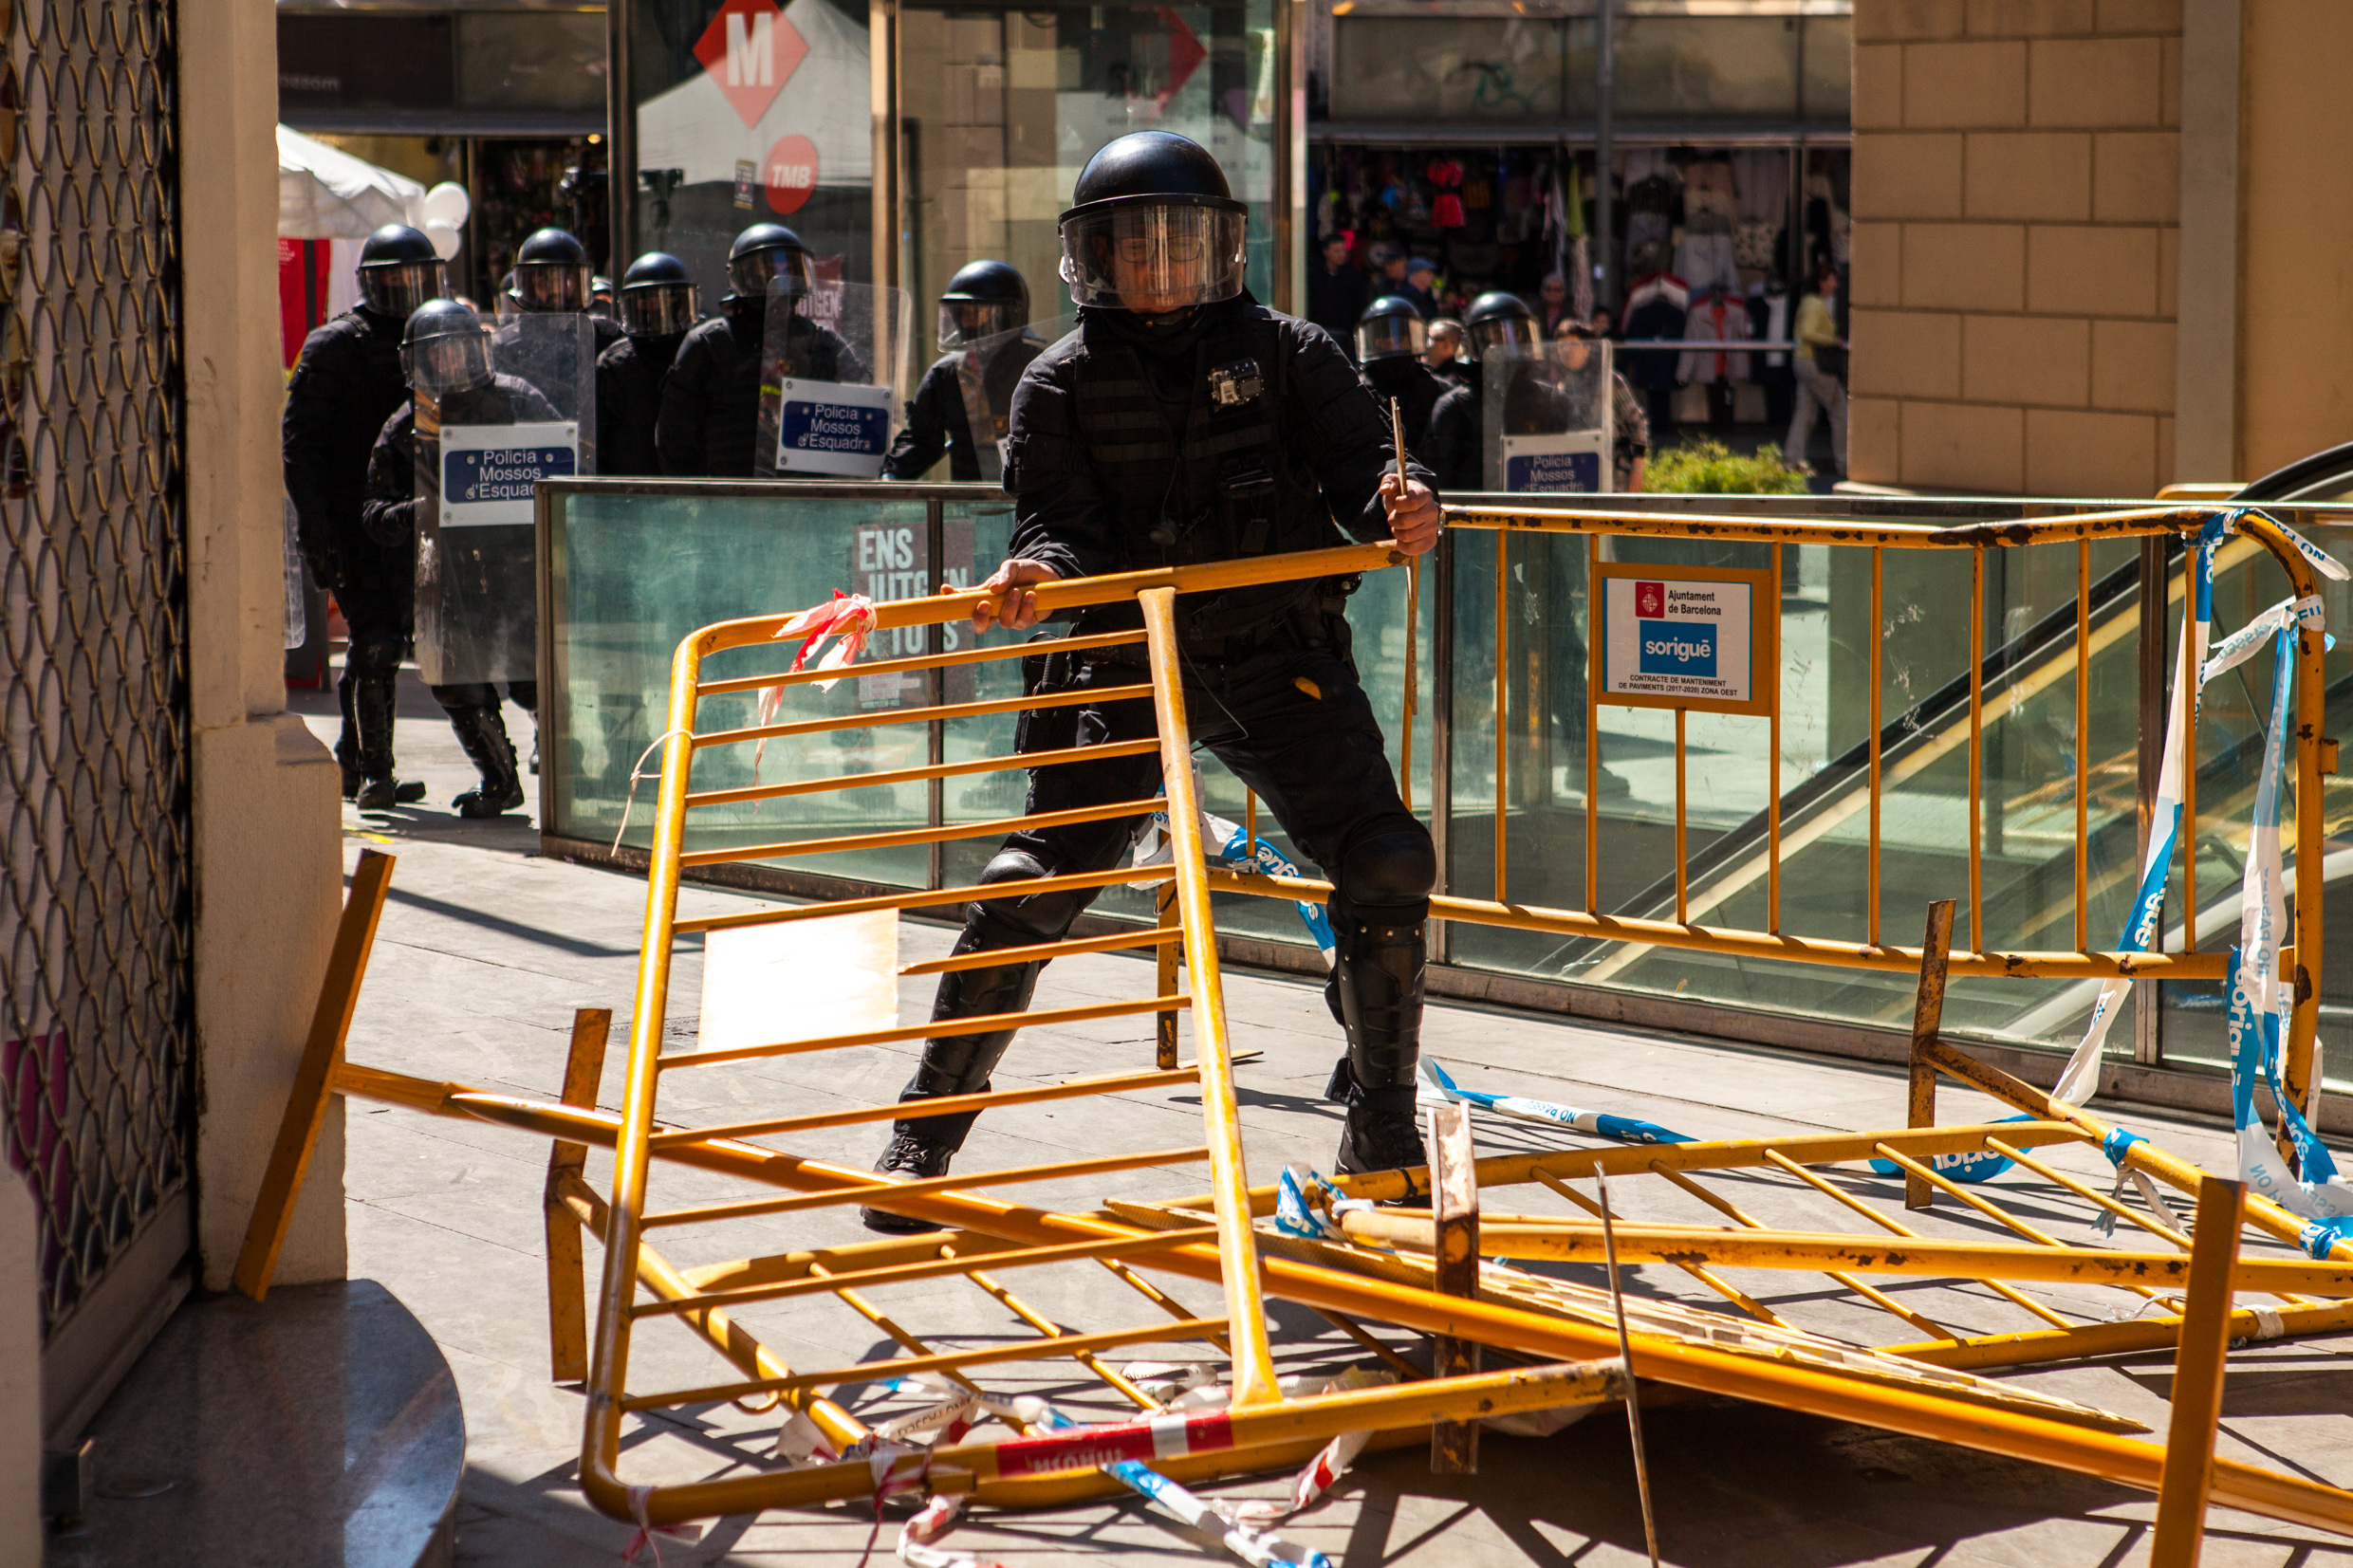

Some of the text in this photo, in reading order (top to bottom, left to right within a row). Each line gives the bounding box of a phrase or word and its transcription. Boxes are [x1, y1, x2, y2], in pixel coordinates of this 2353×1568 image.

[725, 11, 773, 87] M
[771, 165, 811, 189] TMB
[815, 404, 859, 420] Policia
[810, 418, 861, 435] Mossos
[798, 433, 871, 452] d'Esquadra
[483, 449, 537, 466] Policia
[1533, 455, 1572, 469] Policia
[479, 466, 542, 482] Mossos
[1529, 469, 1575, 482] Mossos
[859, 527, 914, 571] ENS
[1668, 589, 1715, 602] Ajuntament
[1668, 603, 1722, 616] de Barcelona
[1629, 674, 1669, 683] CONTRACTE
[1680, 677, 1727, 687] MANTENIMENT
[1628, 683, 1665, 692] PAVIMENTS
[1665, 685, 1700, 694] (2017-2020)
[1700, 687, 1719, 695] ZONA
[1560, 1109, 1577, 1125] NO
